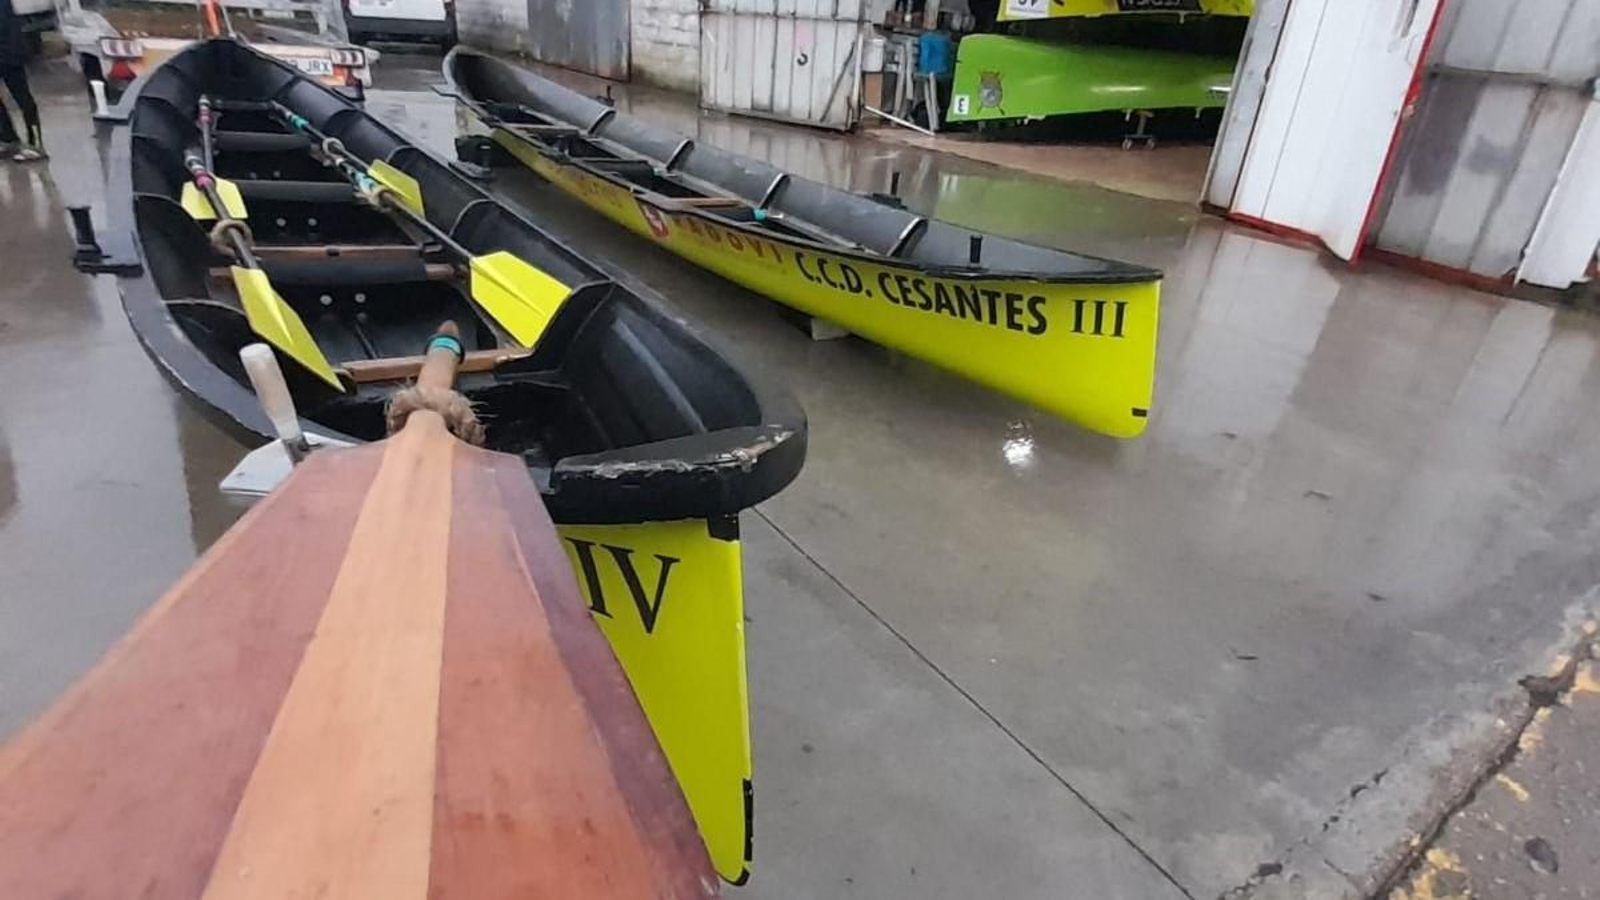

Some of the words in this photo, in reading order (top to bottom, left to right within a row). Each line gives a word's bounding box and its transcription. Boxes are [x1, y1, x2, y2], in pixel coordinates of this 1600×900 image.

[795, 252, 873, 298] C.C.D.
[877, 271, 1048, 336] CESANTES
[1070, 299, 1128, 338] III
[564, 536, 681, 635] IV
